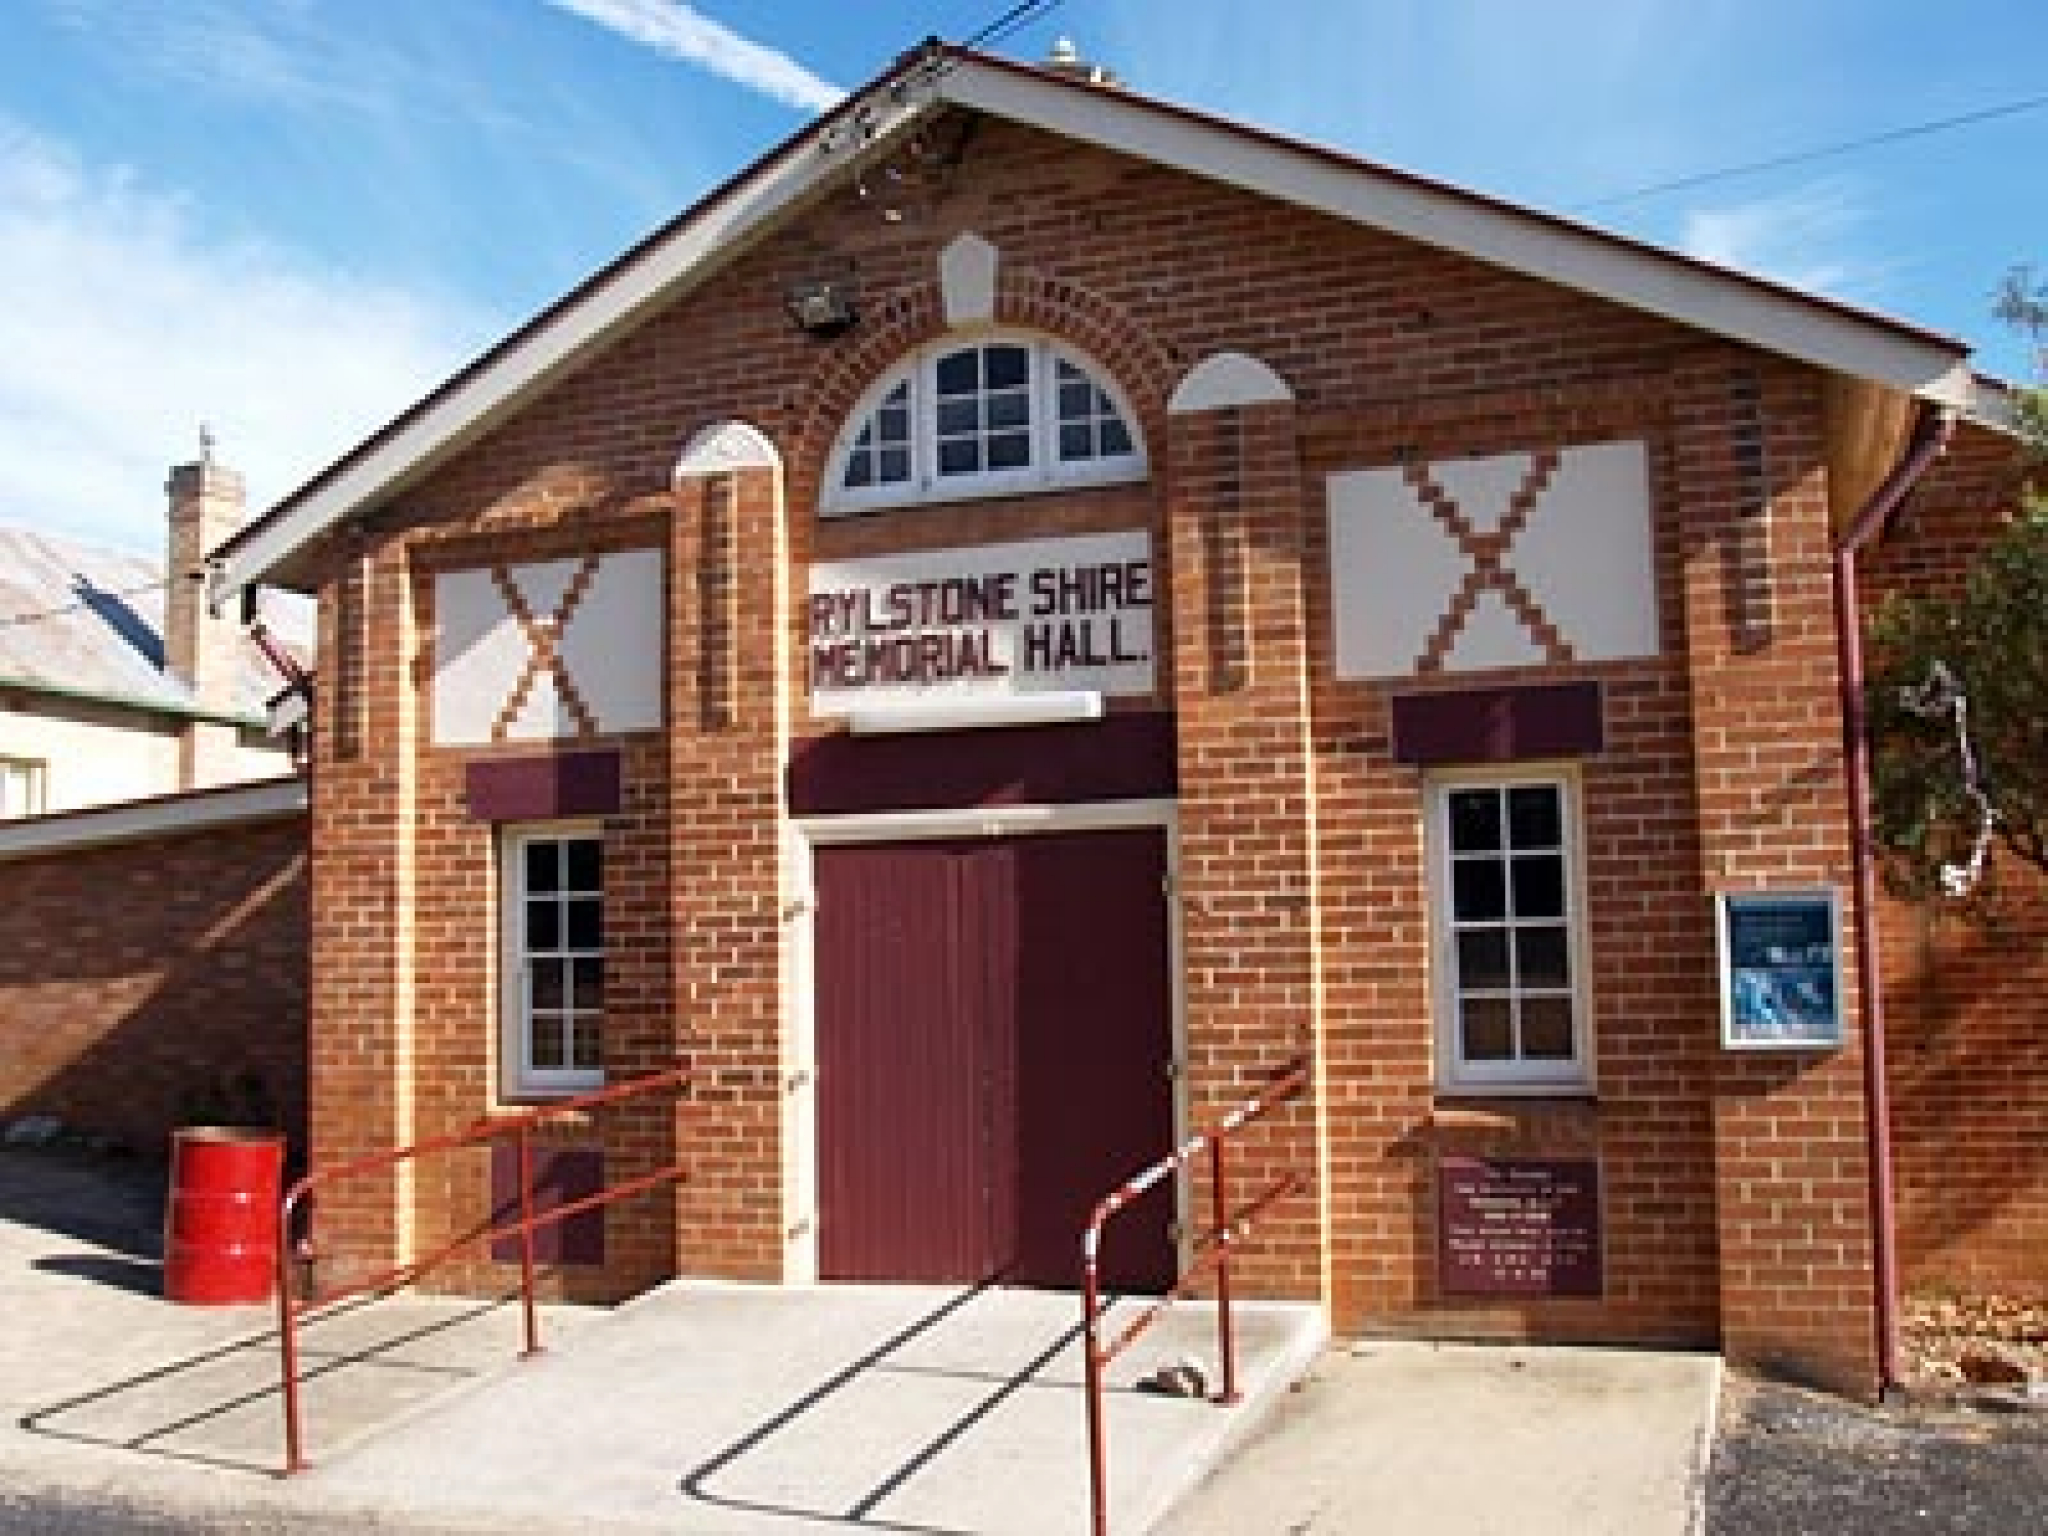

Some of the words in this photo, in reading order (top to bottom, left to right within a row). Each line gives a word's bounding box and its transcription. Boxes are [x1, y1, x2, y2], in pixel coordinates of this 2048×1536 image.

[814, 573, 1018, 635] RYLSTONE
[1031, 563, 1155, 614] SHIRE
[814, 629, 1009, 687] MEMORIAL
